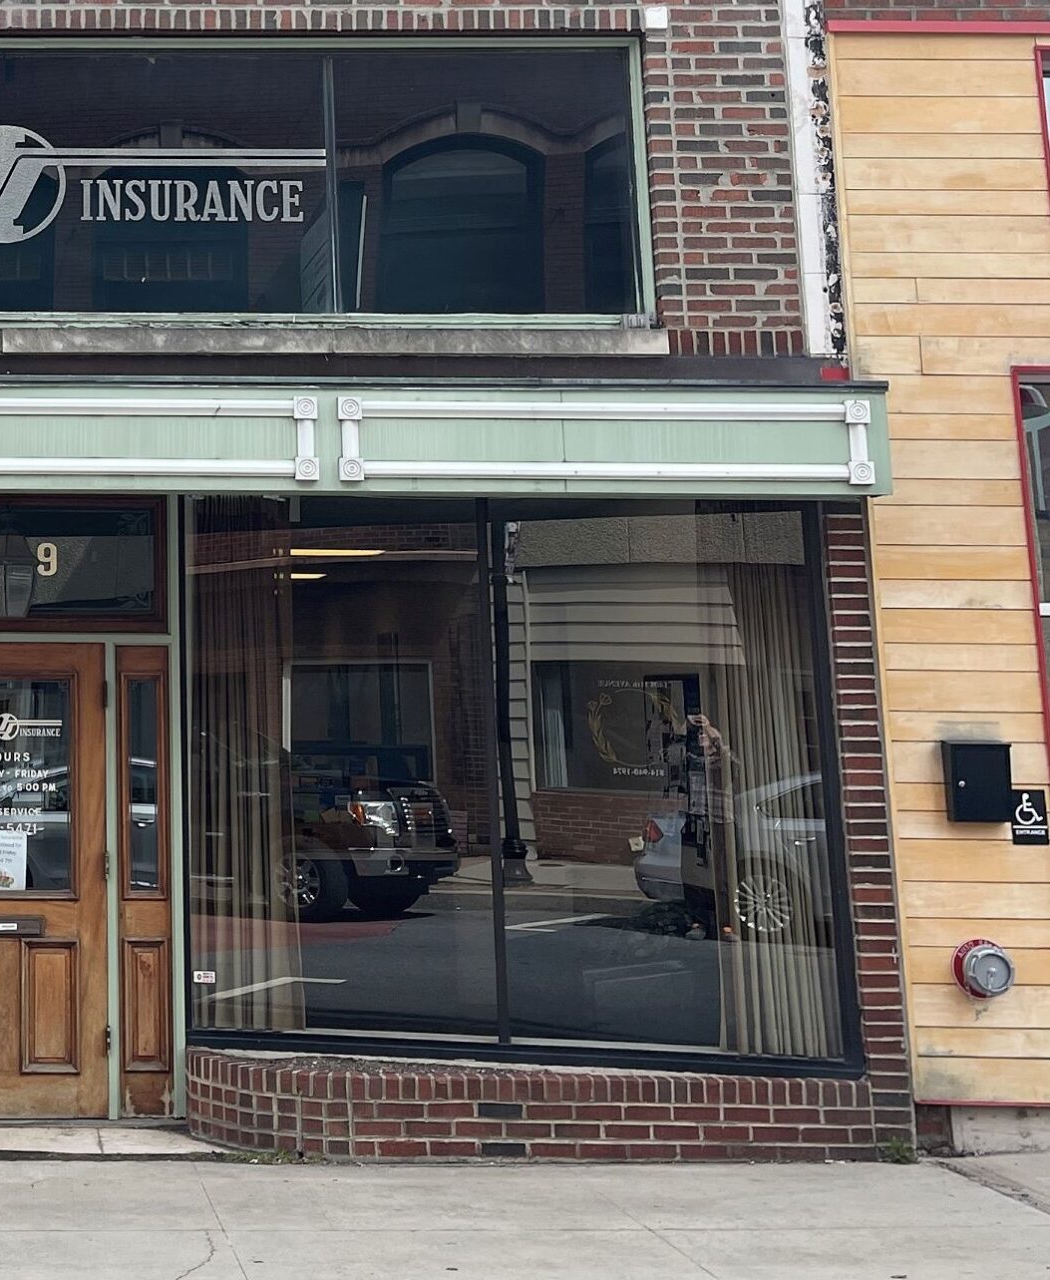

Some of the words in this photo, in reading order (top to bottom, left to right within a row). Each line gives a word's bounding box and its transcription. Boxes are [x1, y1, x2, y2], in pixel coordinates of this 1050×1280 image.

[80, 179, 304, 223] INSURANCE
[19, 727, 61, 737] INSURANCE
[14, 769, 49, 778] FRIDAY
[17, 782, 40, 791] 5:00
